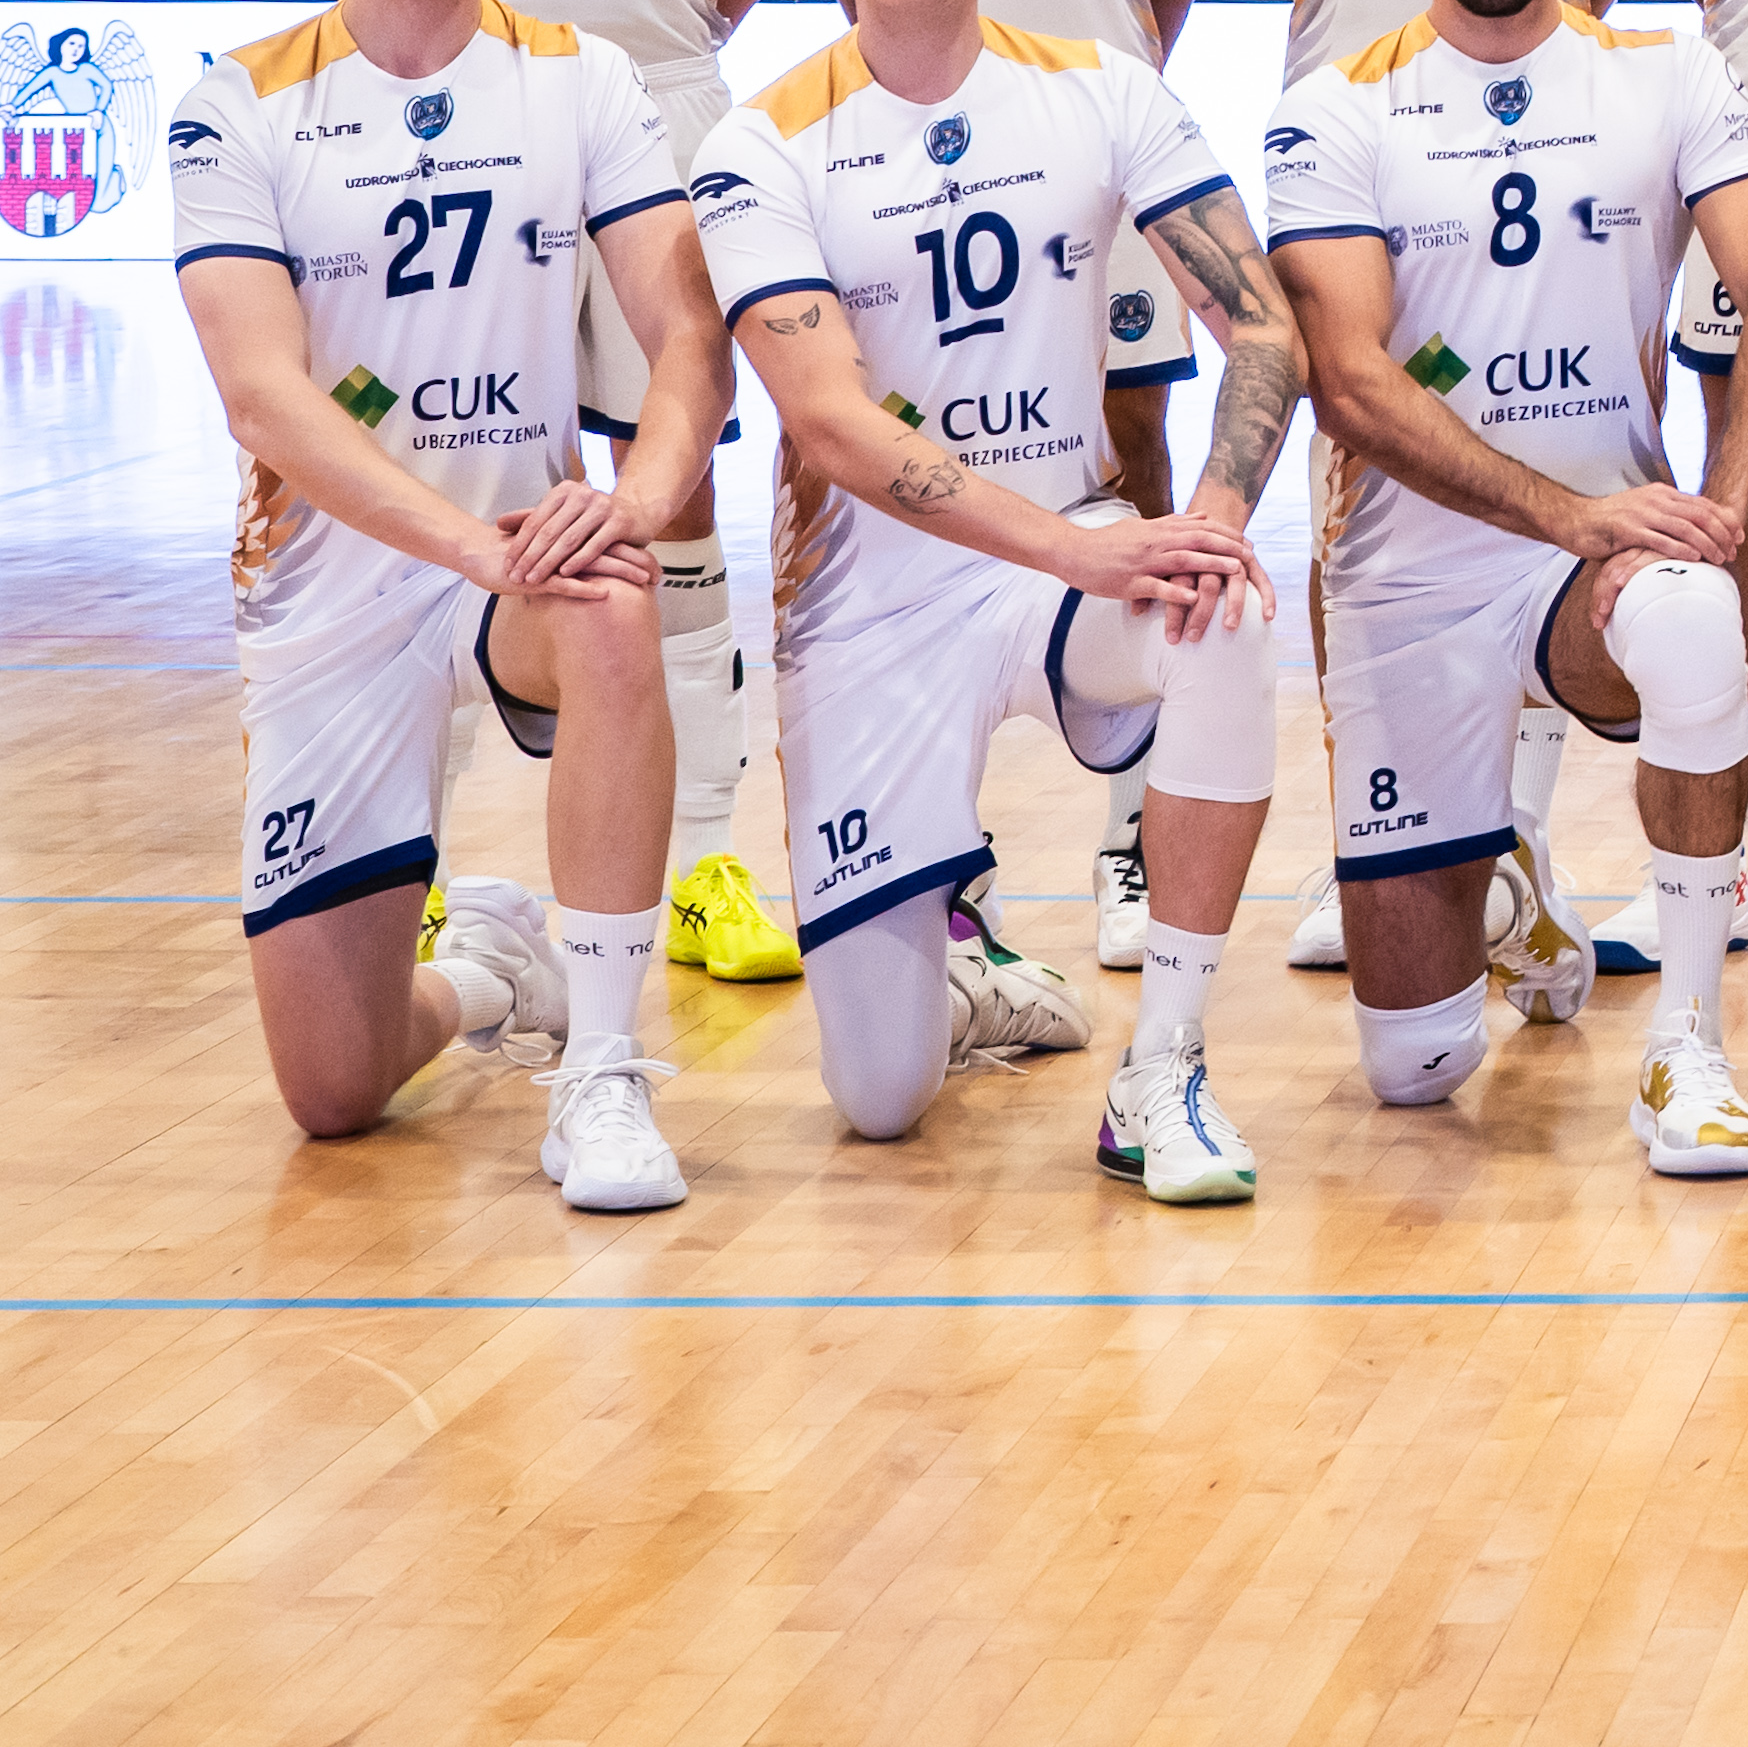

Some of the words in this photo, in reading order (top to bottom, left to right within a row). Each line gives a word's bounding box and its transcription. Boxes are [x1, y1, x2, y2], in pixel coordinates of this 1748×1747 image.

[1426, 147, 1505, 163] UZDROWISKO
[1517, 134, 1598, 155] CIECHOCINEK
[437, 155, 523, 174] CIECHOCINEK
[961, 169, 1046, 198] CIECHOCINEK
[1411, 220, 1462, 235] MIASTO
[1489, 172, 1541, 268] 8
[1597, 207, 1639, 218] KUJAWY
[1597, 217, 1645, 228] POMORZE
[383, 190, 493, 299] 27
[1412, 223, 1469, 252] TORUŃ
[309, 252, 361, 267] MIASTO
[311, 255, 368, 282] TORUŃ
[915, 211, 1019, 323] 10
[842, 283, 892, 301] MIASTO
[1486, 345, 1592, 397] CUK
[411, 372, 520, 422] CUK
[1480, 395, 1631, 427] UBEZPIECZENIA
[940, 387, 1051, 442] CUK
[412, 422, 549, 452] UBEZPIECZENIA
[959, 435, 1085, 469] BEZPIECZENIA
[1369, 768, 1399, 812] 8
[262, 798, 316, 863] 27
[817, 808, 869, 865] 10
[1347, 811, 1429, 839] CUTLINE
